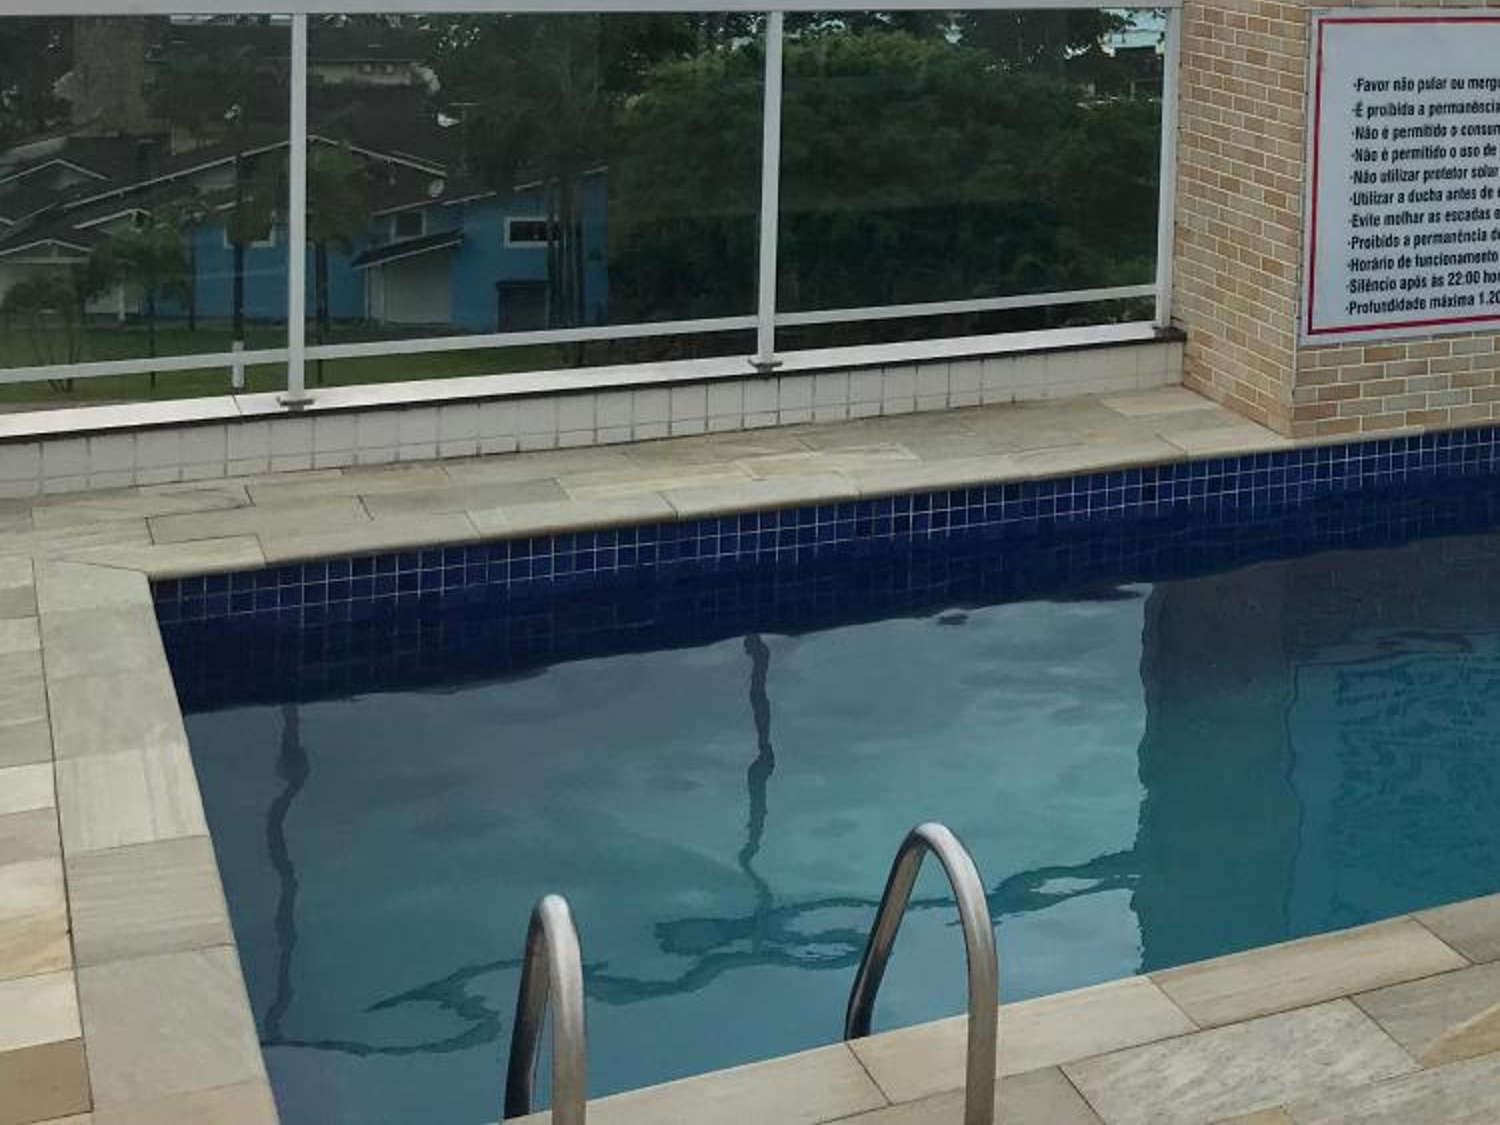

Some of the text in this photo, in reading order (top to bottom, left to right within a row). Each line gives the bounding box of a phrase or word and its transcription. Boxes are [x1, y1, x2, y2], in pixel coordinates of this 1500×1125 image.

[1393, 78, 1414, 90] não
[1417, 77, 1447, 92] pular
[1449, 78, 1464, 88] ou
[1367, 103, 1414, 119] proibida
[1417, 105, 1424, 115] a
[1392, 124, 1447, 141] permitido
[1450, 126, 1458, 136] o
[1391, 145, 1446, 162] permitido
[1449, 147, 1456, 157] o
[1459, 146, 1480, 157] uso
[1482, 143, 1496, 156] de
[1379, 169, 1420, 182] utilizar
[1422, 167, 1468, 183] protetor
[1470, 165, 1498, 178] solar
[1397, 192, 1404, 203] a
[1407, 189, 1442, 202] ducha
[1445, 187, 1476, 200] antes
[1479, 186, 1494, 198] de
[1383, 211, 1424, 225] molhar
[1427, 212, 1441, 222] as
[1444, 208, 1490, 221] escadas
[1493, 209, 1500, 219] e
[1402, 236, 1410, 246] a
[1412, 230, 1486, 248] permanência
[1397, 256, 1412, 268] de
[1414, 250, 1498, 267] funcionamento
[1399, 276, 1427, 291] após
[1429, 295, 1474, 309] máxima
